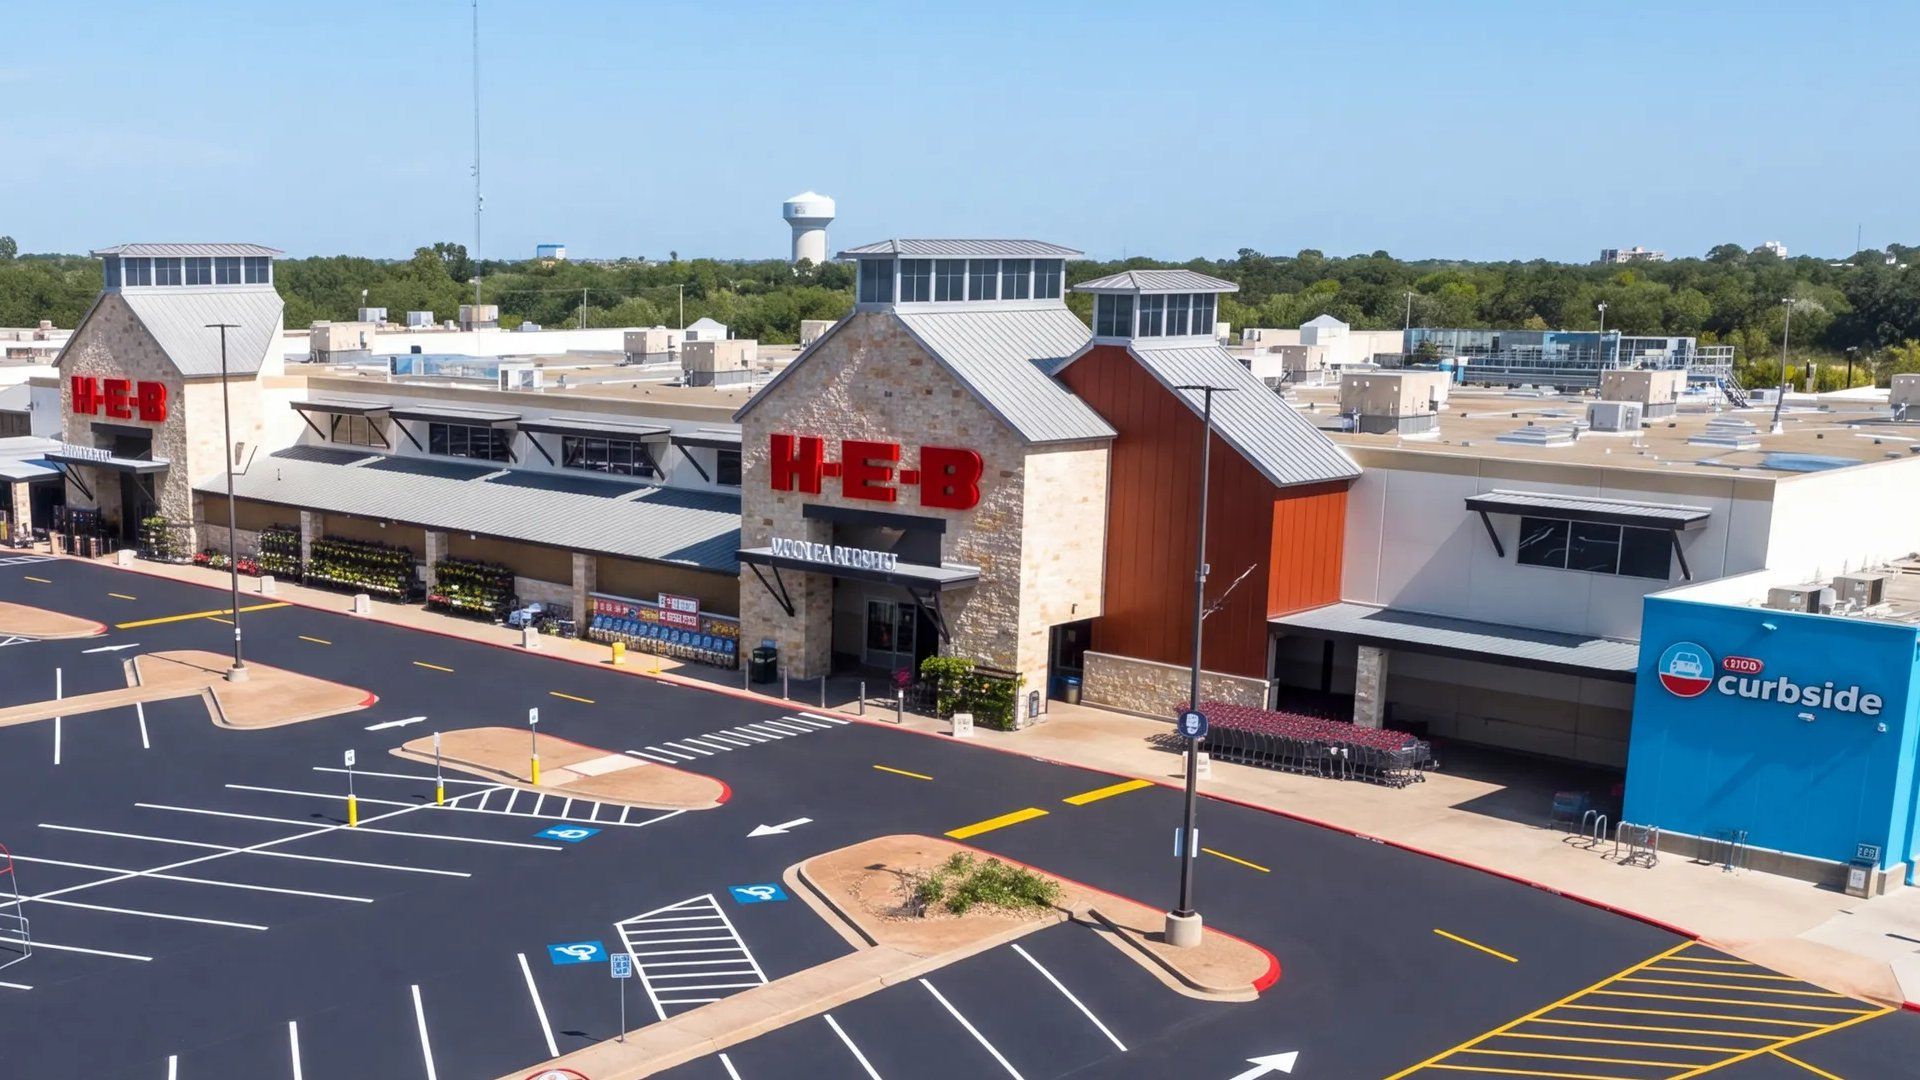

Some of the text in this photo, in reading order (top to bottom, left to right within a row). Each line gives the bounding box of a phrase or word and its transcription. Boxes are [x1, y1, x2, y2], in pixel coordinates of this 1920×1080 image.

[71, 376, 167, 422] H-E-B
[771, 434, 983, 510] H-E-B
[1717, 675, 1883, 715] curbside
